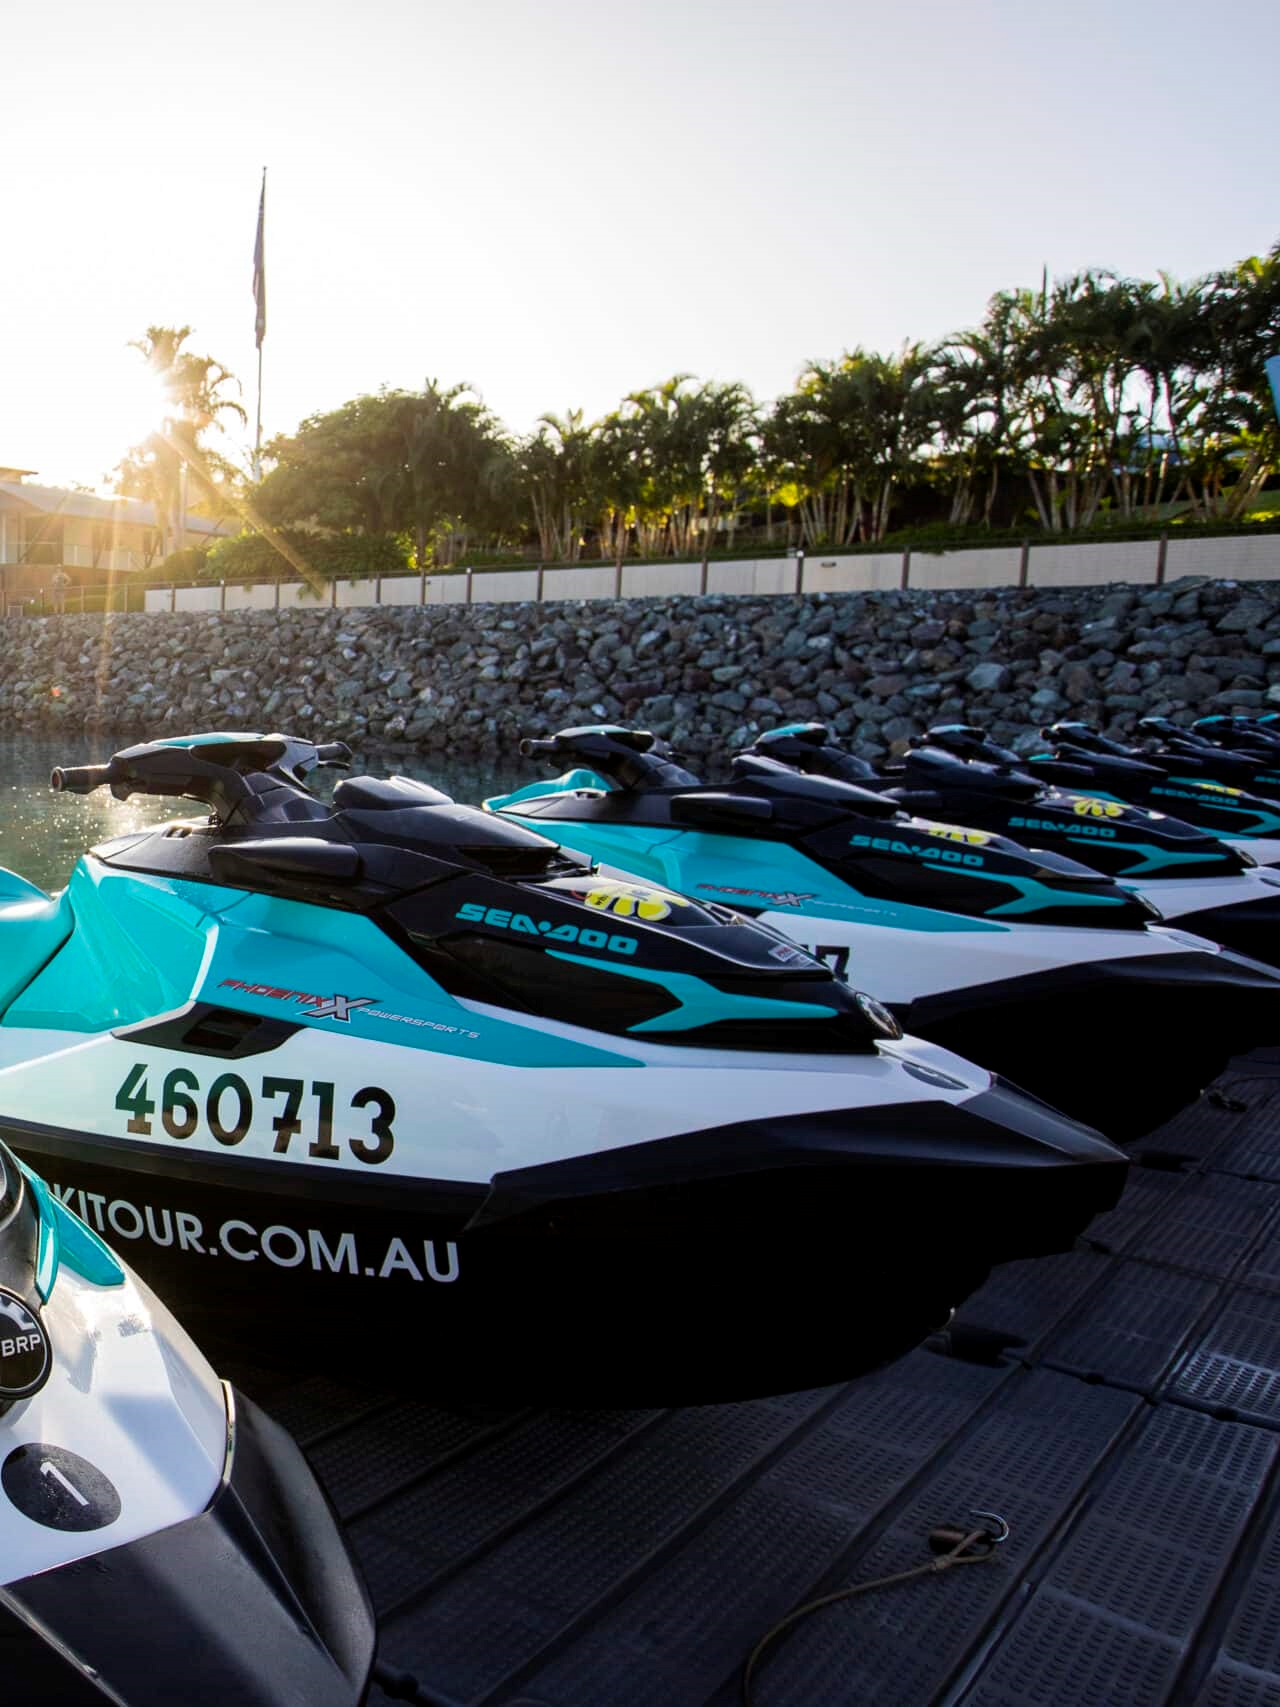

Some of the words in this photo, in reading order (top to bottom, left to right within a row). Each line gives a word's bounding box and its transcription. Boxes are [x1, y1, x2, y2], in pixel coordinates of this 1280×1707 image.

[218, 979, 333, 1008] PHOENIX
[356, 1005, 481, 1039] POWERSPORTS
[115, 1063, 396, 1165] 460713
[1, 1333, 41, 1357] BRP
[39, 1461, 90, 1507] 1
